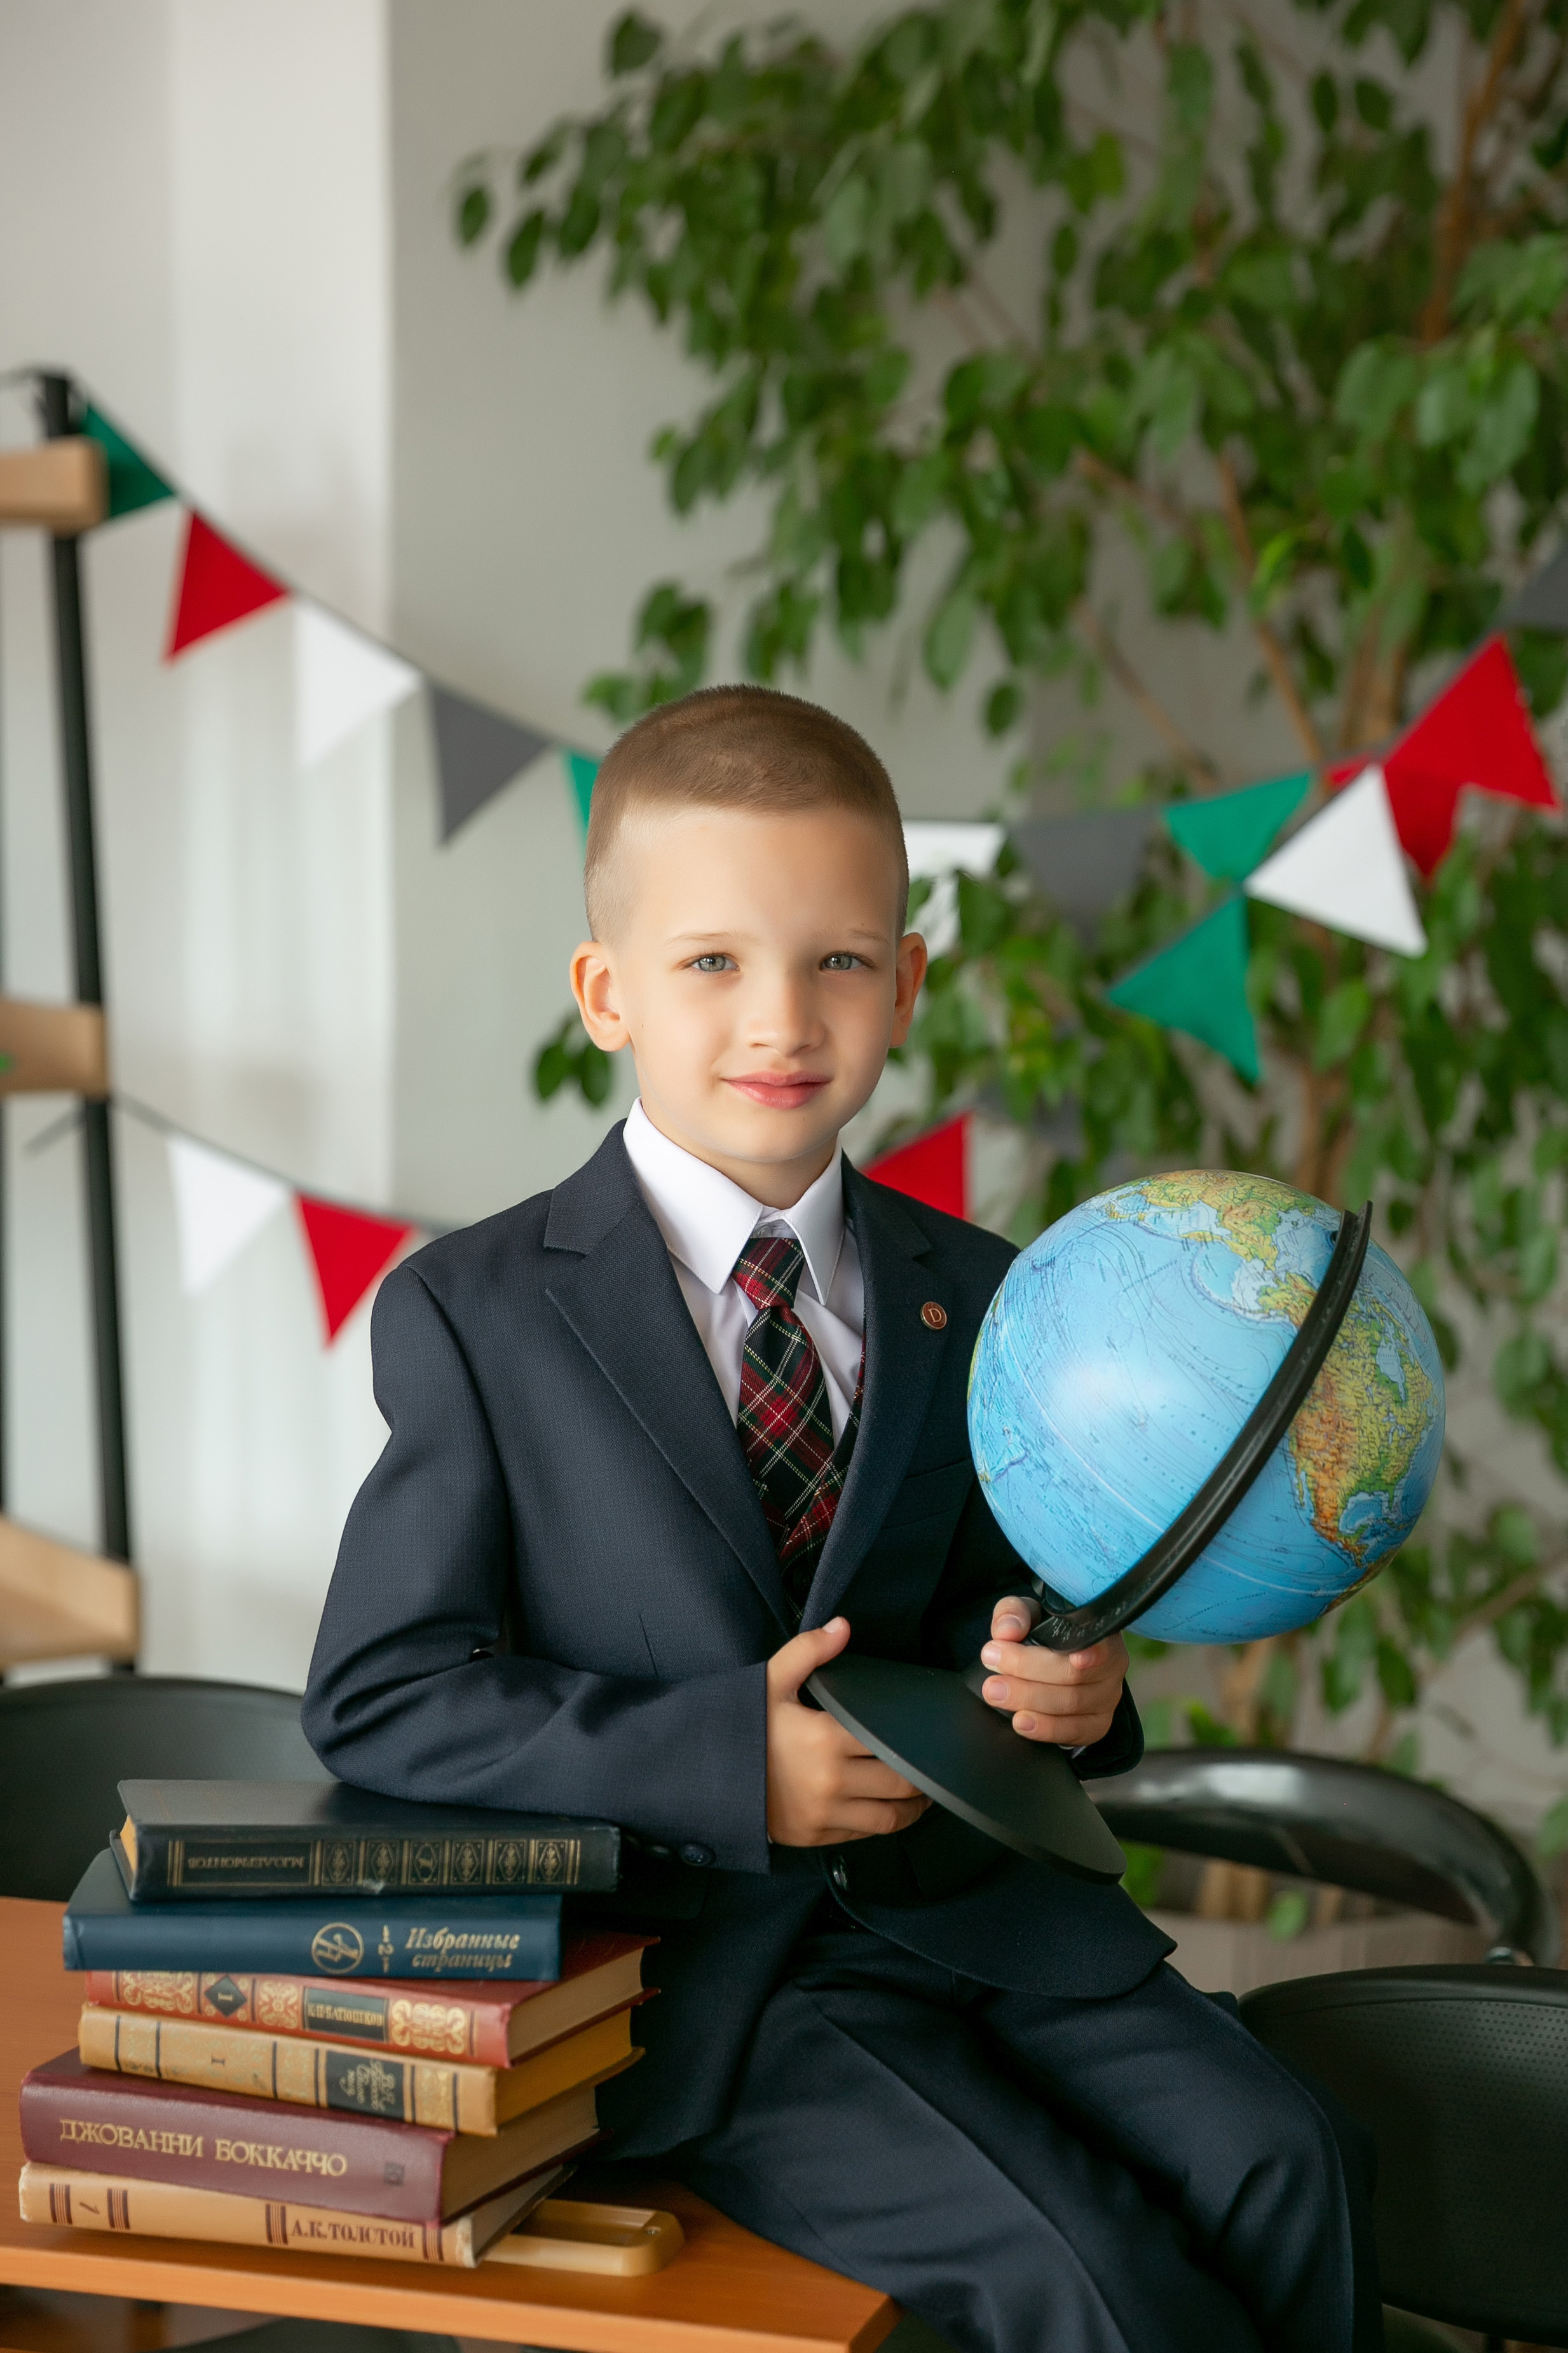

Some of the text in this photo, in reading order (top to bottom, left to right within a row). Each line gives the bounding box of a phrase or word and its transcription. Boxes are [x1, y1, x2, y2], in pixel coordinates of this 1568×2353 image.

[928, 1308, 942, 1323] D
[405, 1926, 520, 1954] Избранные
[412, 1952, 512, 1972] страницы
[59, 2118, 348, 2177] ДЖОВАННИ БОККАЧЧО
[292, 2220, 415, 2248] А.К.ТОЛСТОЙ
